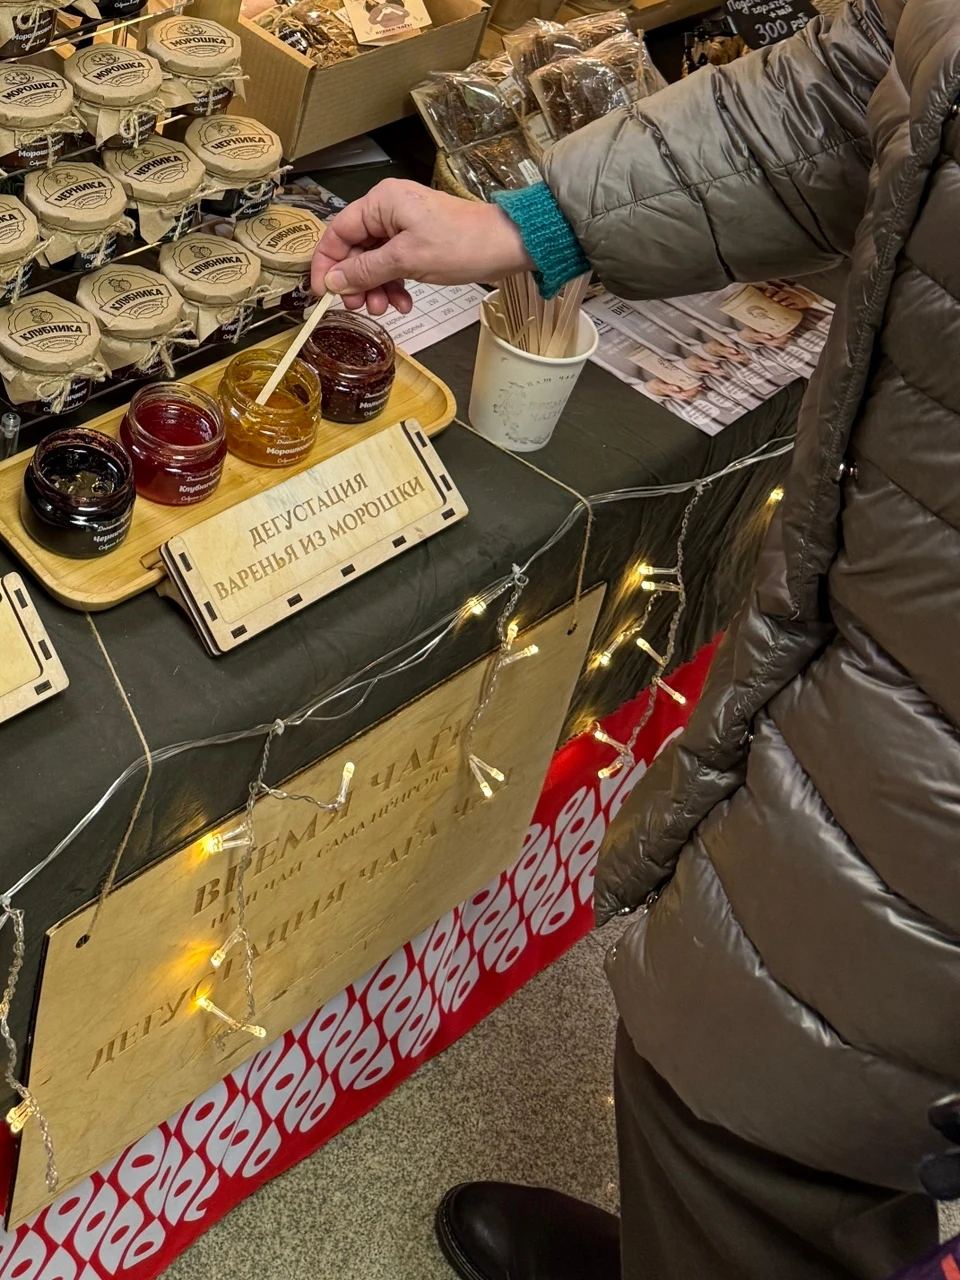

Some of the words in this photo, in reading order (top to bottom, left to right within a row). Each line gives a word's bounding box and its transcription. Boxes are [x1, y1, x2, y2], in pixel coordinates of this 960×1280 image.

[169, 34, 227, 48] МОРОШКА
[754, 20, 788, 45] 300
[93, 59, 145, 80] МОРОШКА
[1, 80, 58, 101] МОРОШКА
[213, 135, 265, 150] ЧЕРНИКА
[136, 153, 182, 177] ЧЕРНИКА
[54, 180, 107, 203] ЧЕРНИКА
[266, 223, 313, 248] КЛУБНИКА
[189, 254, 244, 276] КЛУБНИКА
[110, 288, 164, 312] КЛУБНИКА
[20, 323, 83, 342] КЛУБНИКА
[248, 472, 370, 549] ДЕГУСТАЦИЯ
[212, 540, 302, 602] ВАРЕНЬЯ
[302, 530, 328, 558] ИЗ
[330, 476, 426, 543] МОРОШКИ
